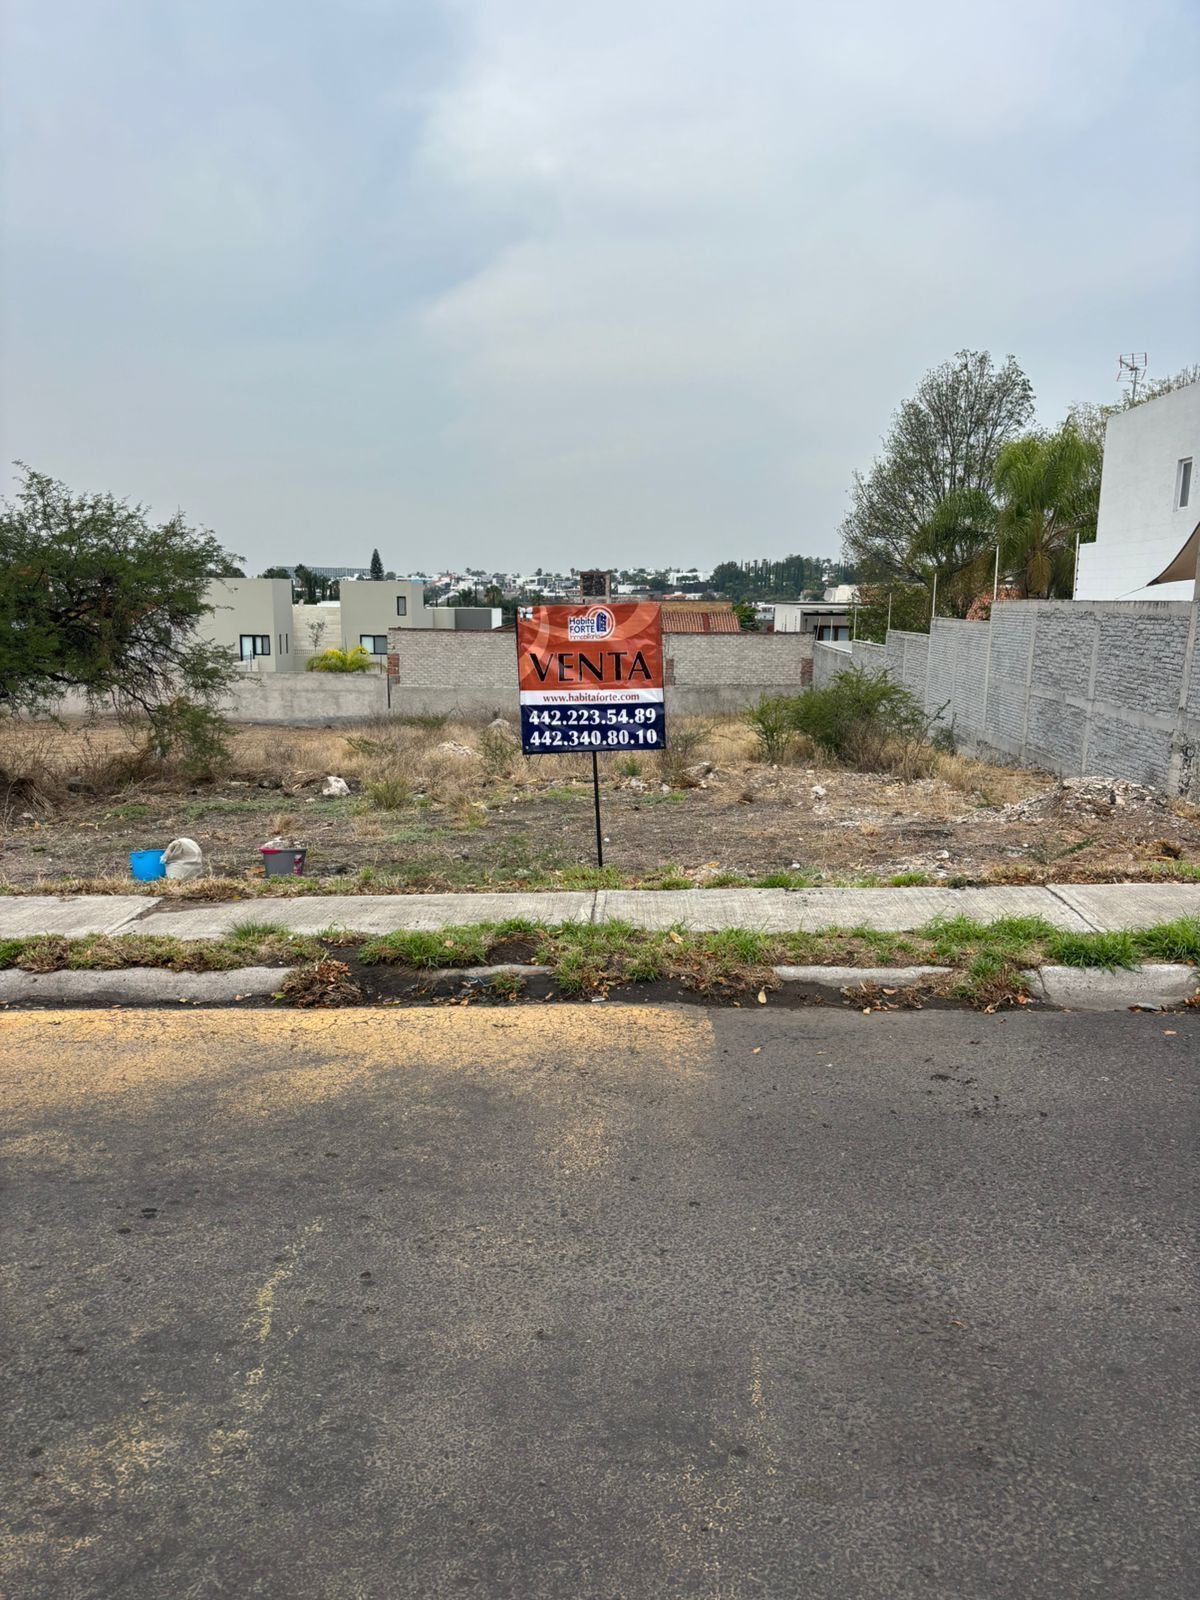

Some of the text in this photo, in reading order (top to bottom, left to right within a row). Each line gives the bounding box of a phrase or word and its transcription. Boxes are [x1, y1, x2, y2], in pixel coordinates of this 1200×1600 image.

[569, 617, 595, 625] Habita
[569, 625, 595, 633] FORTE
[529, 651, 653, 682] VENTA
[542, 693, 640, 702] www.habitaforte.com
[528, 708, 657, 725] 442.223.54.89
[530, 729, 658, 746] 442.340.80.10
